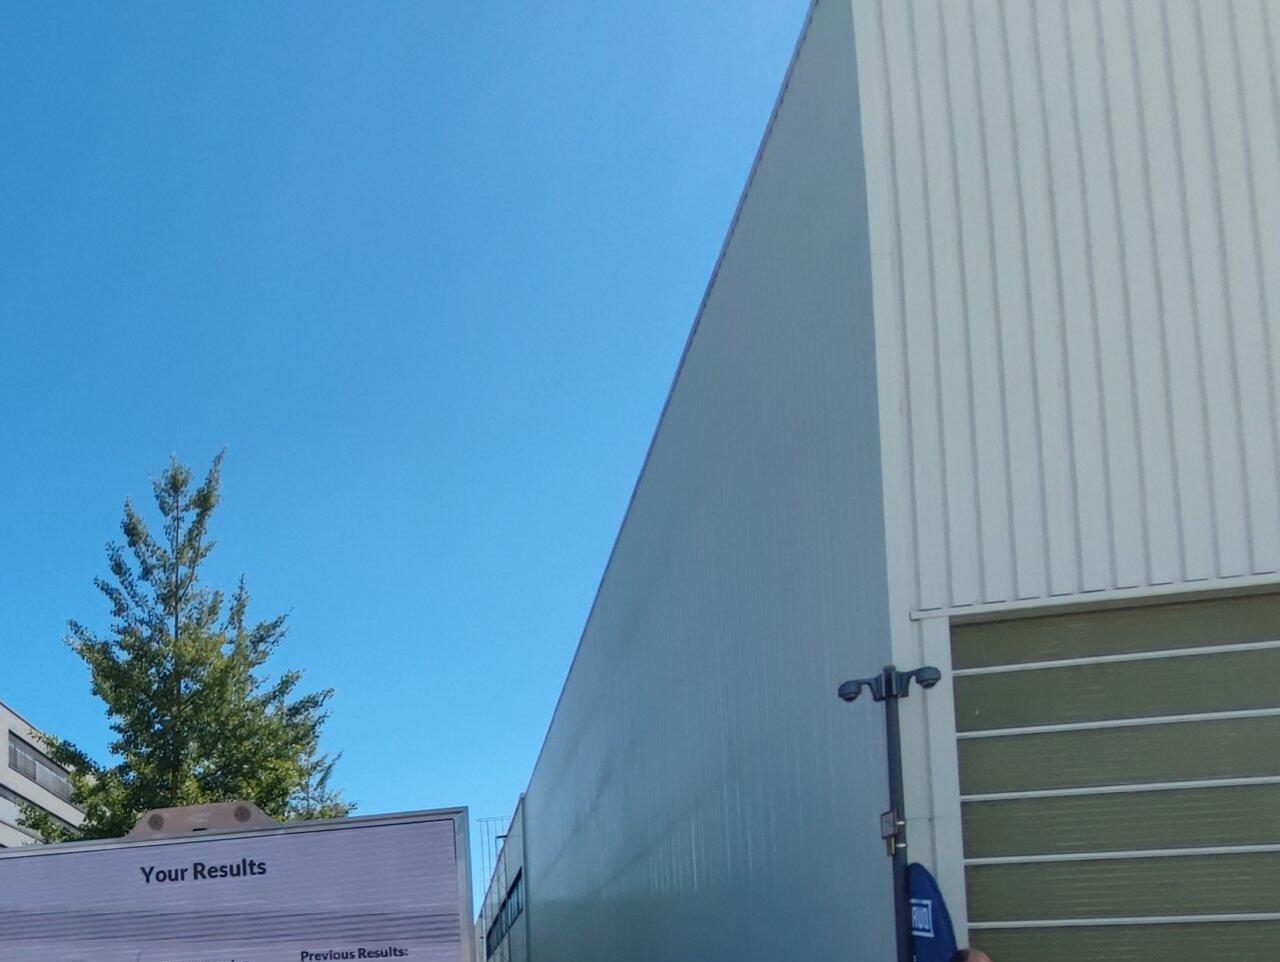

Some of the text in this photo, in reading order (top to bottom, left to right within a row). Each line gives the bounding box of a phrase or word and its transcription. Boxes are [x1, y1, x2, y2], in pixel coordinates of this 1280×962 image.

[140, 858, 267, 883] Your Results
[300, 946, 409, 962] Previous Results:
